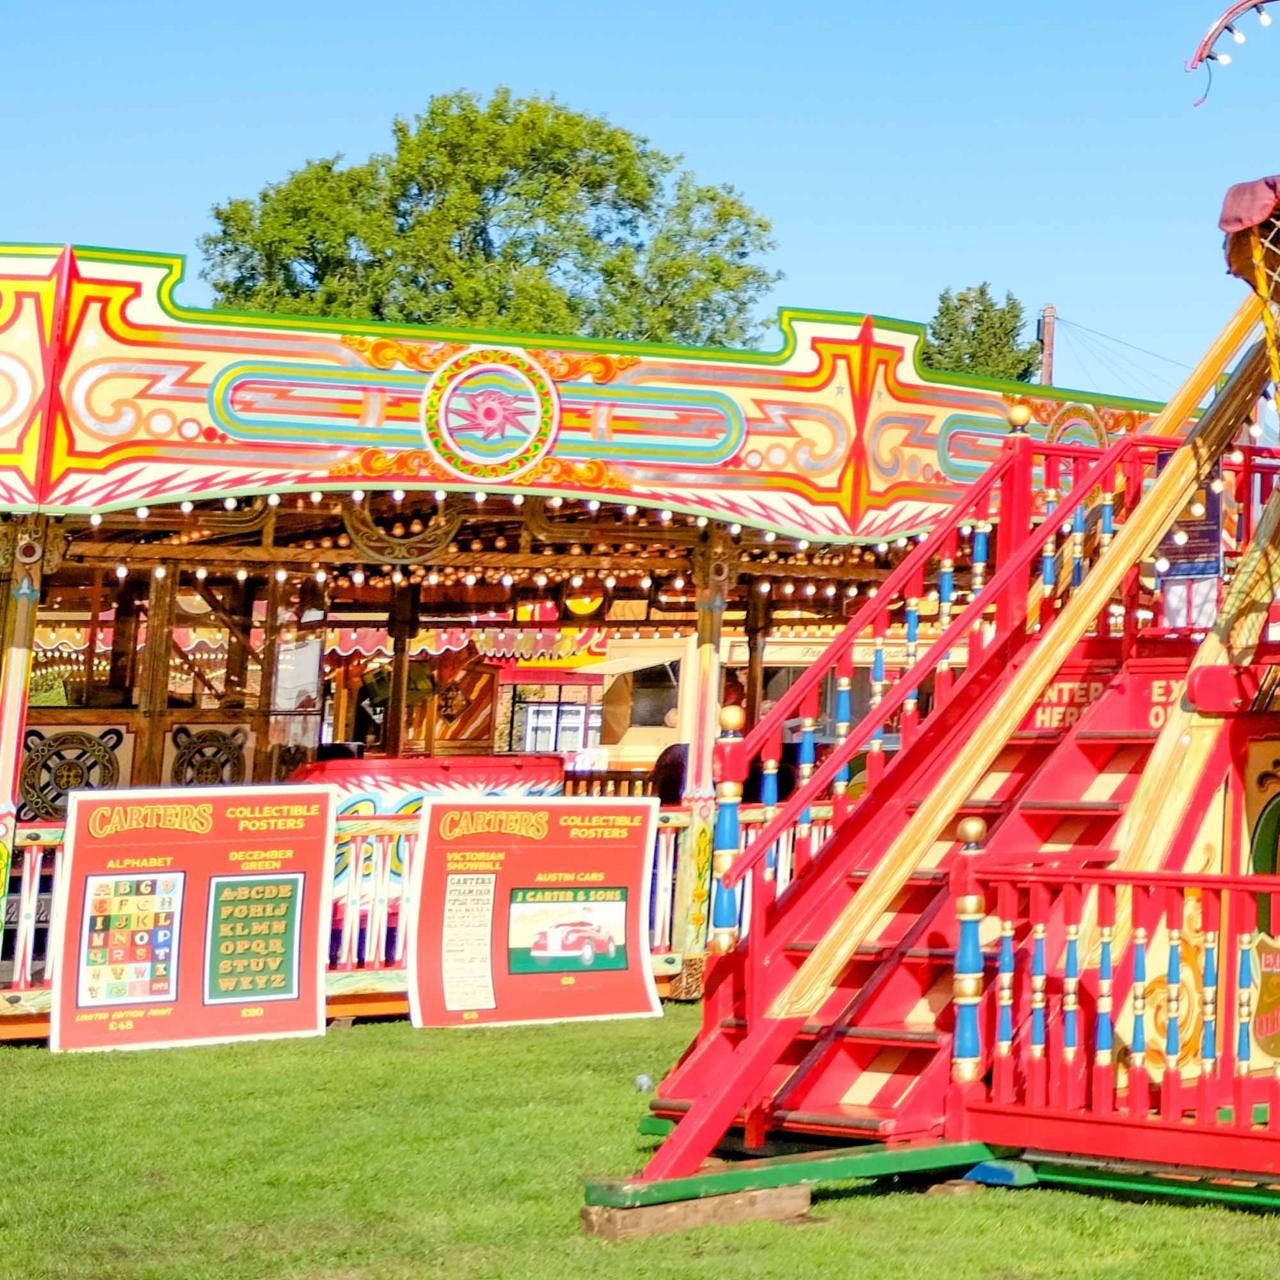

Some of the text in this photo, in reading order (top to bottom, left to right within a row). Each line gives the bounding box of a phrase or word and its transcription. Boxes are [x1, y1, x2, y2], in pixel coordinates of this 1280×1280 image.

[1038, 681, 1105, 704] NTER
[1034, 706, 1090, 729] HER
[226, 805, 320, 818] COLLECTIBLE
[89, 803, 213, 838] CARTERS
[238, 818, 305, 831] POSTERS
[440, 810, 549, 840] CARTERS
[559, 815, 643, 827] COLLECTIBLE
[569, 827, 629, 839] POSTERS
[229, 850, 294, 861] DECEMBER
[446, 851, 506, 862] VICTORIAN
[107, 857, 174, 869] ALPHABET
[241, 860, 281, 871] GREEN
[446, 861, 503, 871] SHOWBILL
[535, 872, 605, 882] AUSTIN CARS
[526, 891, 573, 902] CARTER
[575, 890, 587, 902] &
[588, 890, 621, 902] SONS
